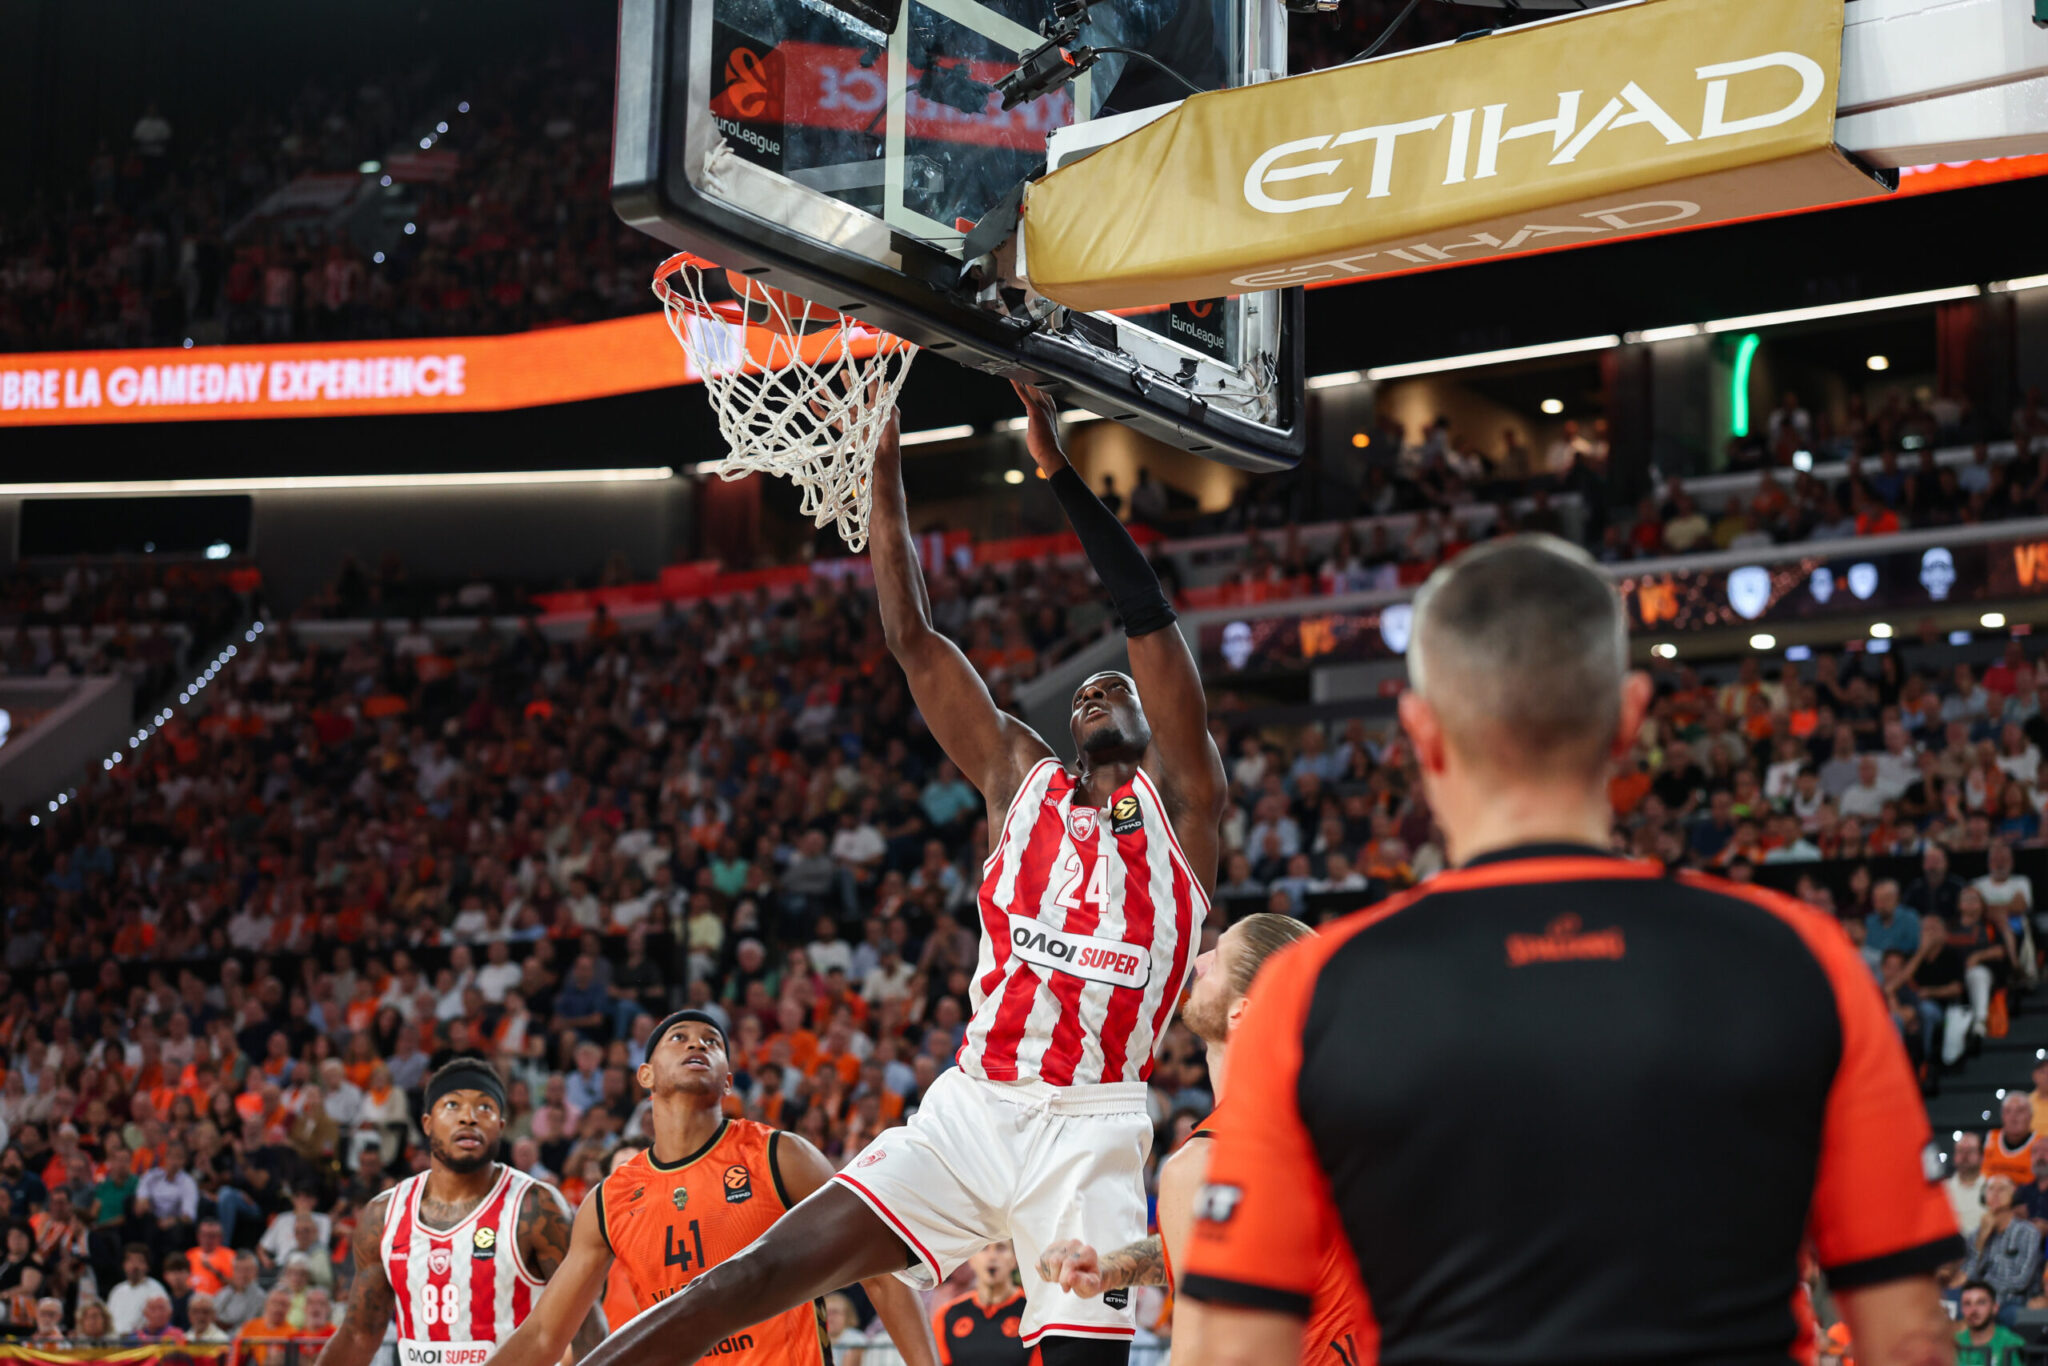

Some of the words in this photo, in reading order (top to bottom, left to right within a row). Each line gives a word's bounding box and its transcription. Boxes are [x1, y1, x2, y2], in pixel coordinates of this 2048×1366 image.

[710, 111, 780, 155] uroLeague
[1243, 51, 1825, 214] ETIHAD
[1229, 200, 1701, 287] ETIHAD
[1171, 314, 1224, 348] EuroLeague
[0, 369, 60, 410] BRE
[64, 367, 102, 409] LA
[106, 361, 265, 407] GAMEDAY
[268, 354, 466, 402] EXPERIENCE
[1054, 852, 1110, 914] 24
[1078, 947, 1139, 976] SUPER
[664, 1219, 705, 1272] 41
[421, 1283, 459, 1325] 88
[445, 1349, 487, 1364] SUPER
